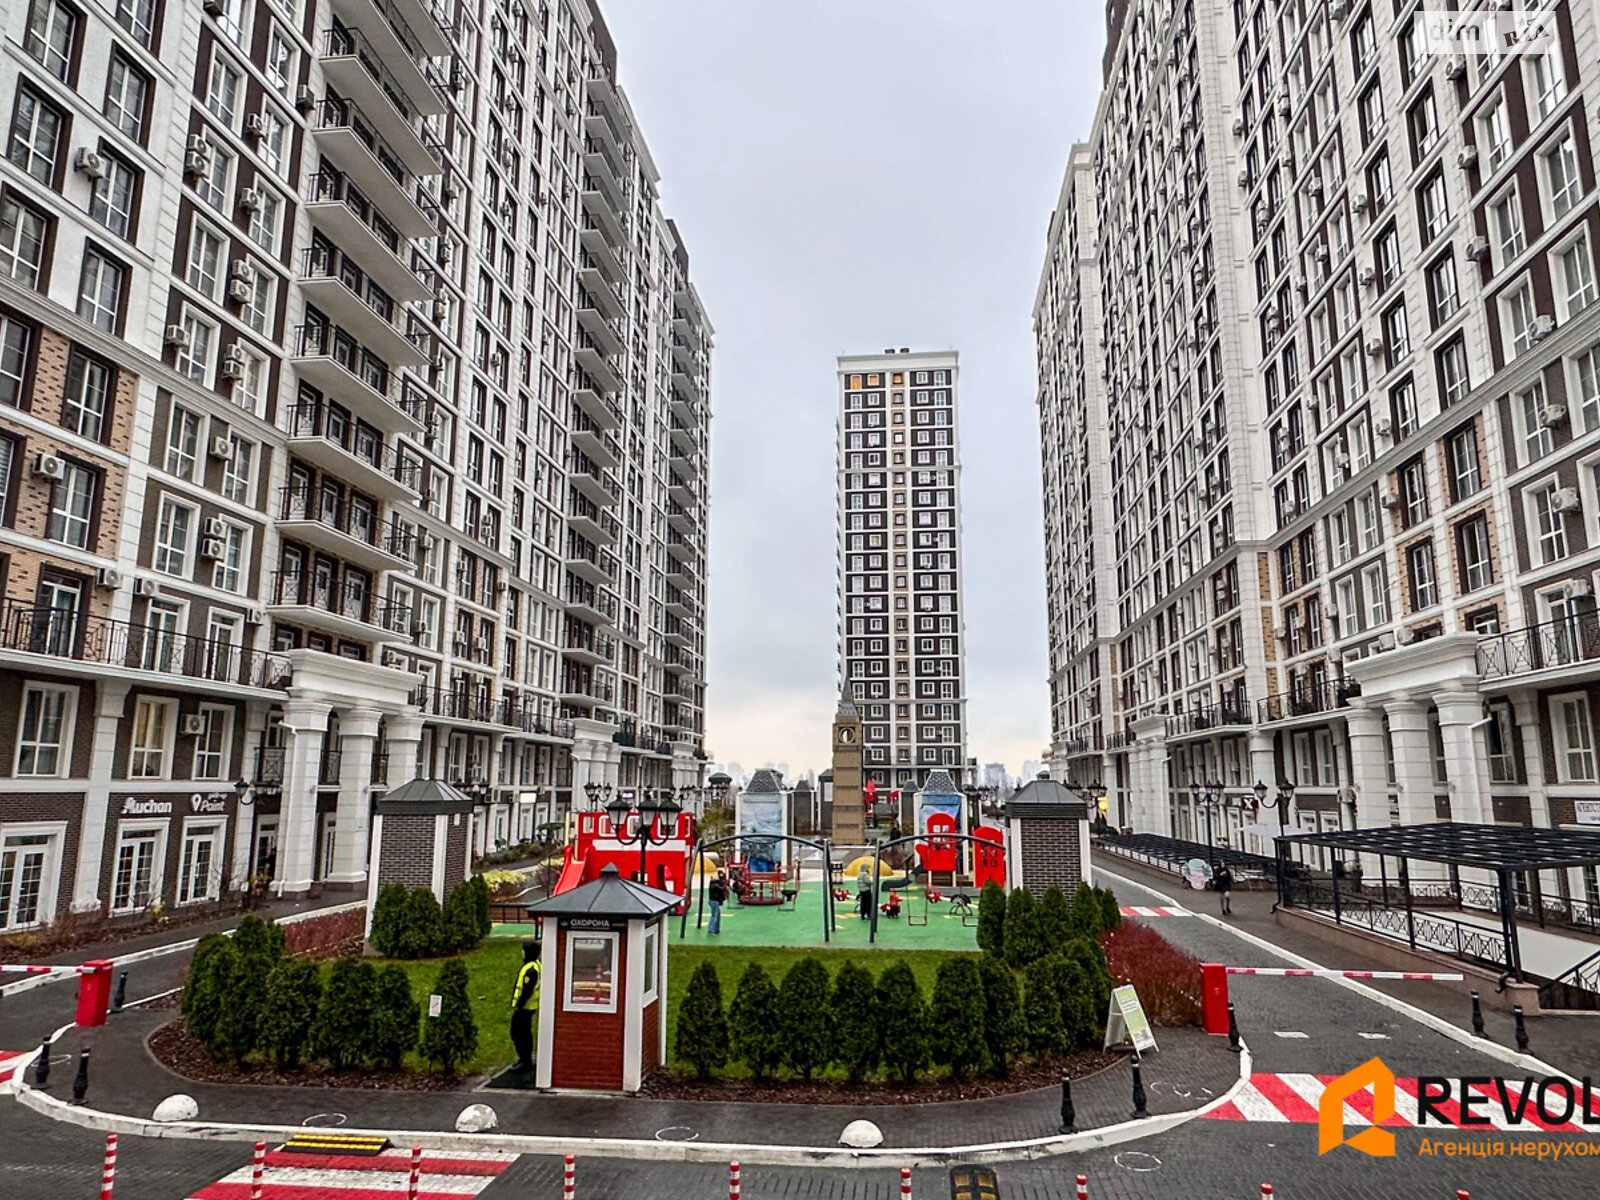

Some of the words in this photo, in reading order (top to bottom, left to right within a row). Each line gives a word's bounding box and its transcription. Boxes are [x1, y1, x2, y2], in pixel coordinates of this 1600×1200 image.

[121, 797, 172, 814] Auchan
[199, 799, 225, 812] Point
[570, 919, 610, 927] ОХОРОНА
